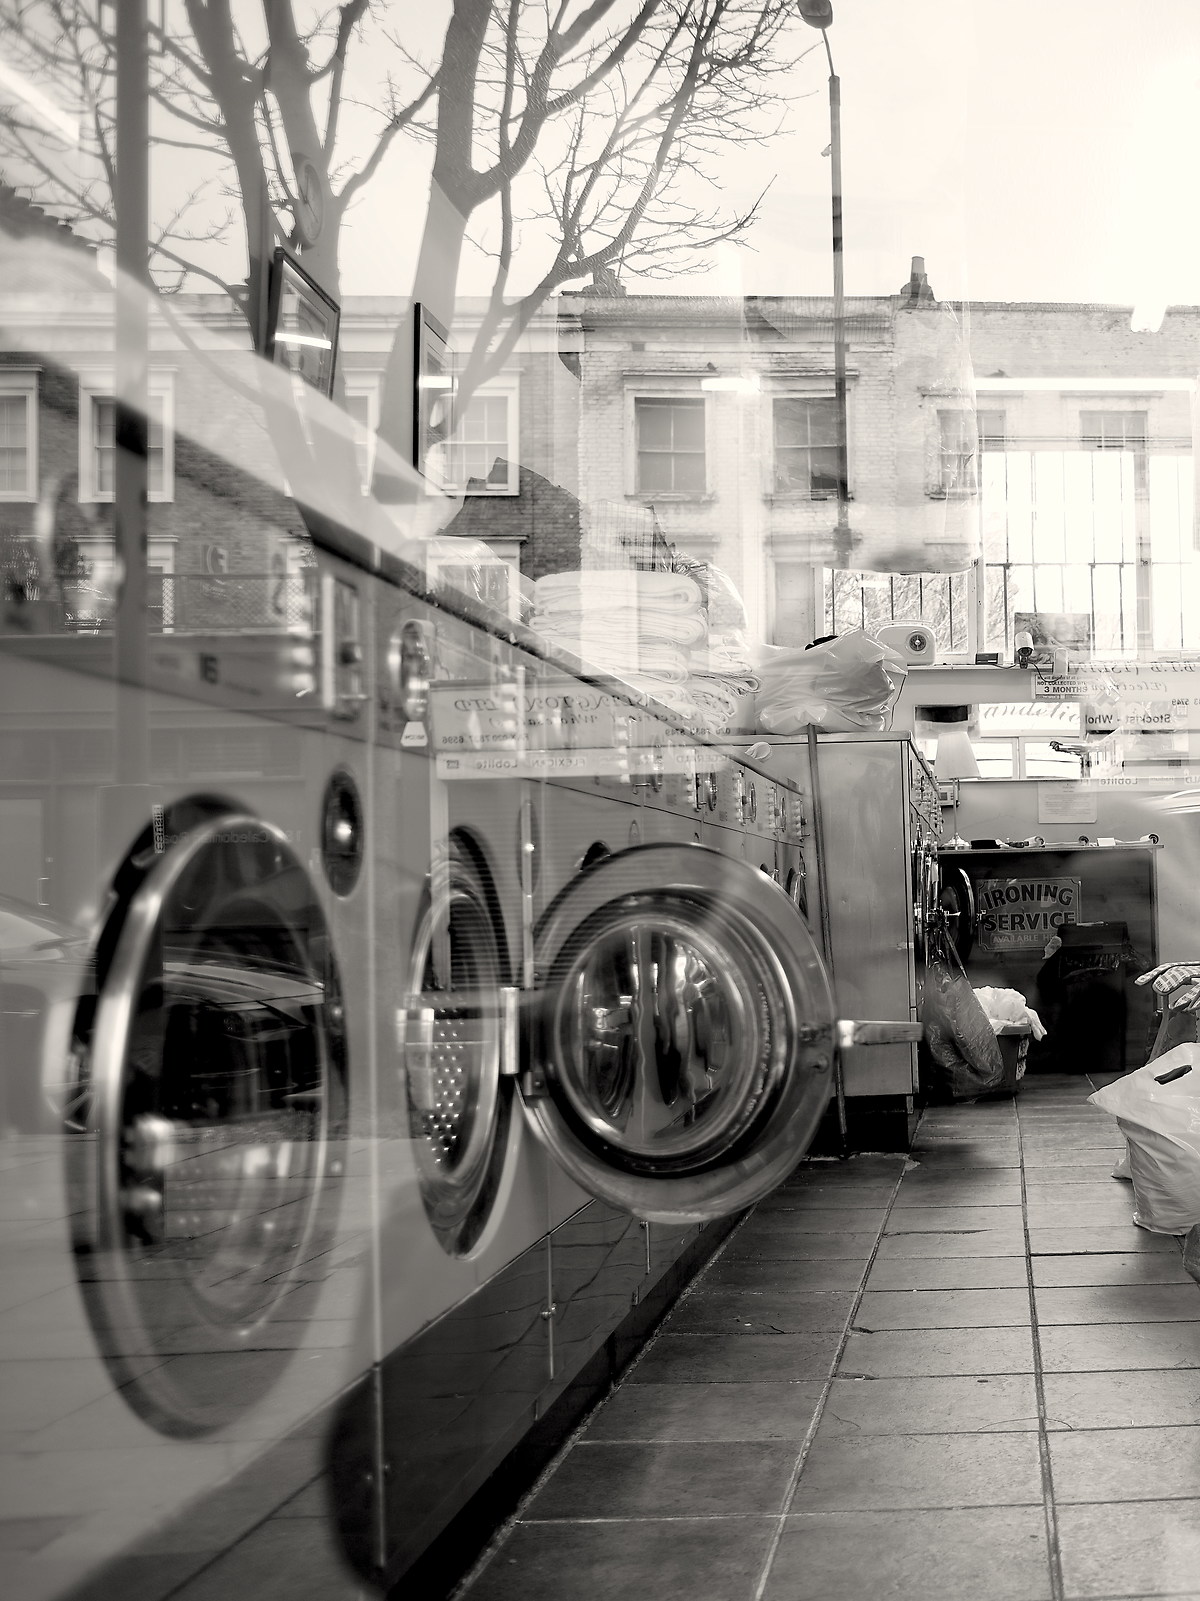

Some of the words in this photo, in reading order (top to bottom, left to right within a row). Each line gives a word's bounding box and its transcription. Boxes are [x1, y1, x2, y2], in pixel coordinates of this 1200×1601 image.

[983, 884, 1073, 910] IRONING
[984, 912, 1076, 931] SERVICE
[992, 934, 1038, 943] AVAILABLE
